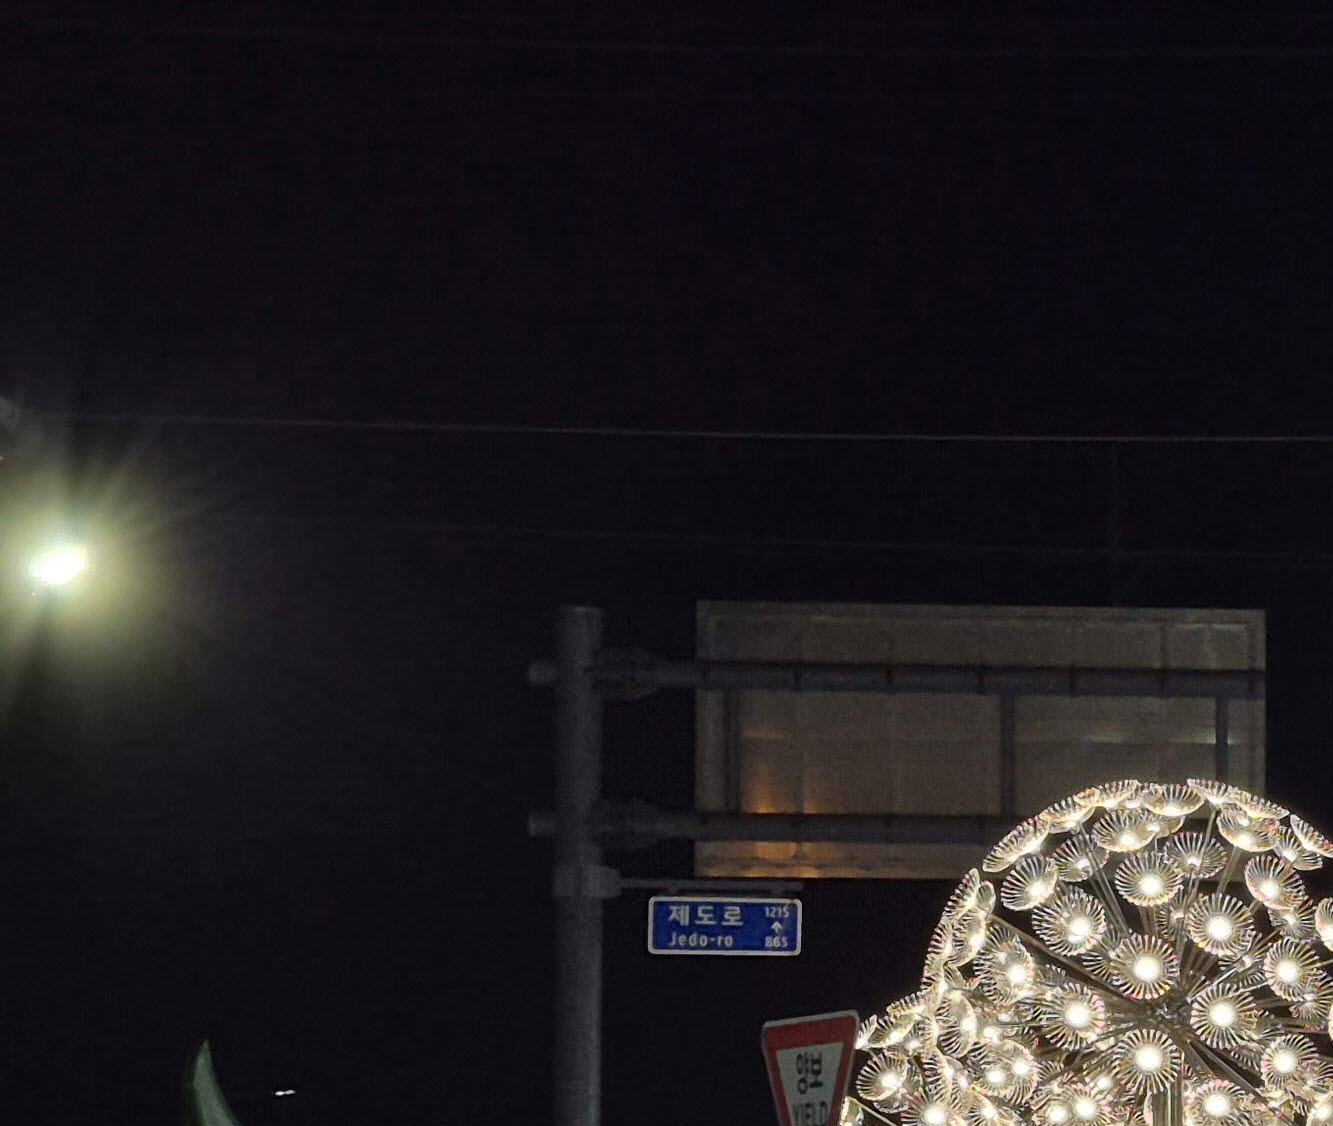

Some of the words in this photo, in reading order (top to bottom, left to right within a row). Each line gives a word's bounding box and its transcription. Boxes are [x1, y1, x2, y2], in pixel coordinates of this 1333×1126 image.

[668, 905, 744, 926] 제도로
[669, 932, 734, 947] Jedo-ro
[796, 1051, 824, 1095] 양보
